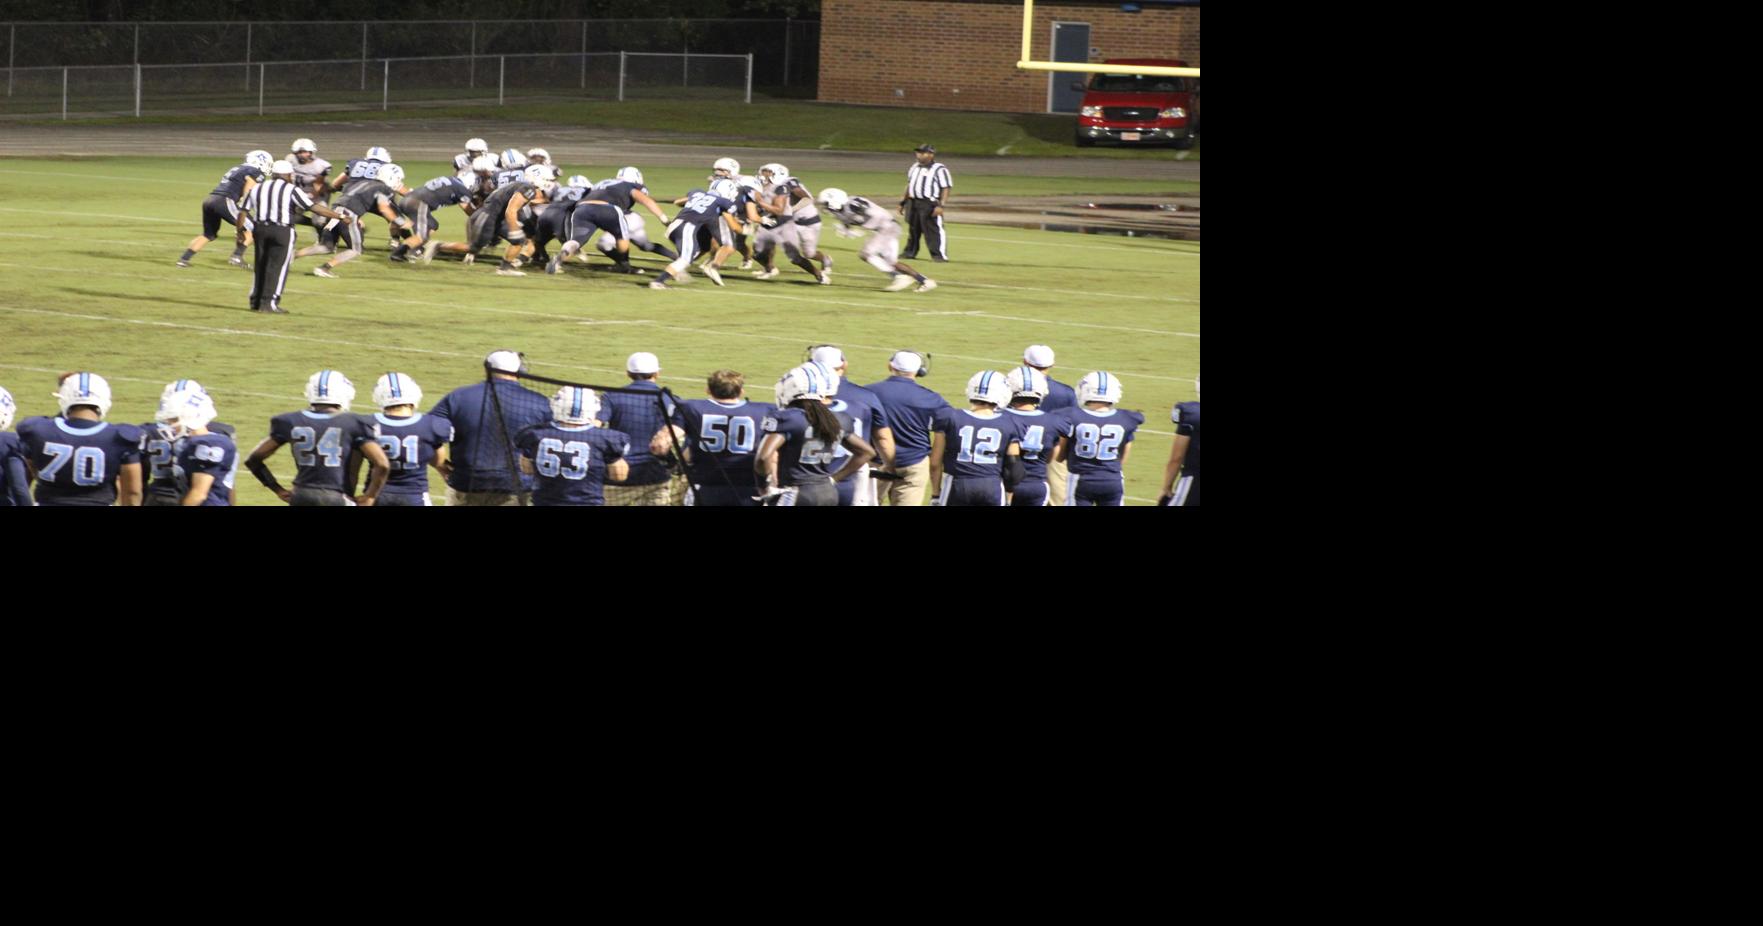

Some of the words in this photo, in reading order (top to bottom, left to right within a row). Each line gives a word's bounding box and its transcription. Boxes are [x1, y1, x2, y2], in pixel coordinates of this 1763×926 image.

[290, 426, 343, 467] 24
[379, 434, 420, 470] 21
[699, 413, 757, 455] 50
[956, 425, 1003, 465] 12
[1074, 422, 1126, 461] 82
[38, 440, 106, 487] 70
[535, 437, 591, 480] 63
